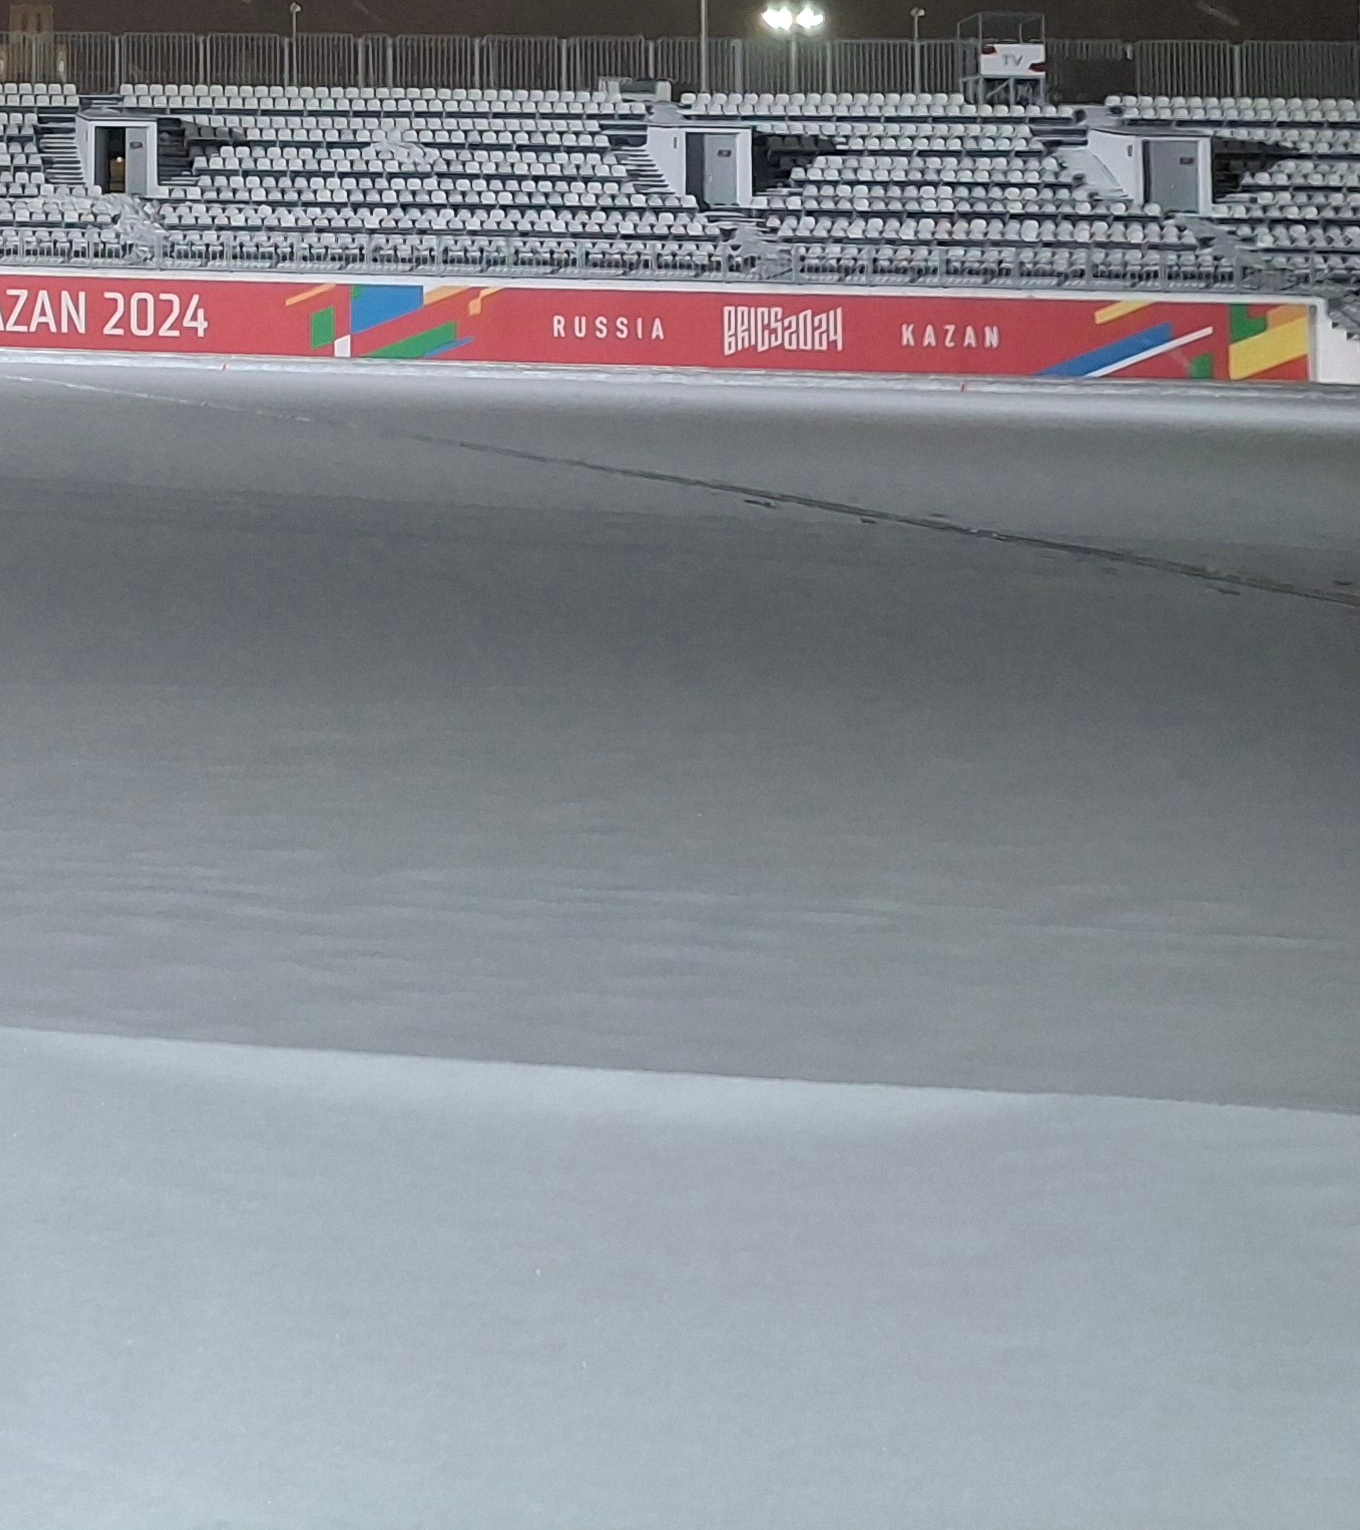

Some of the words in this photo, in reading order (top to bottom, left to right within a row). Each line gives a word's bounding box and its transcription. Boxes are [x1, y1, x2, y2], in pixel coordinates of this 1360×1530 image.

[1002, 54, 1023, 66] TV
[103, 291, 208, 338] 2024
[552, 315, 665, 340] RUSSIA
[900, 323, 1001, 349] KAZAN
